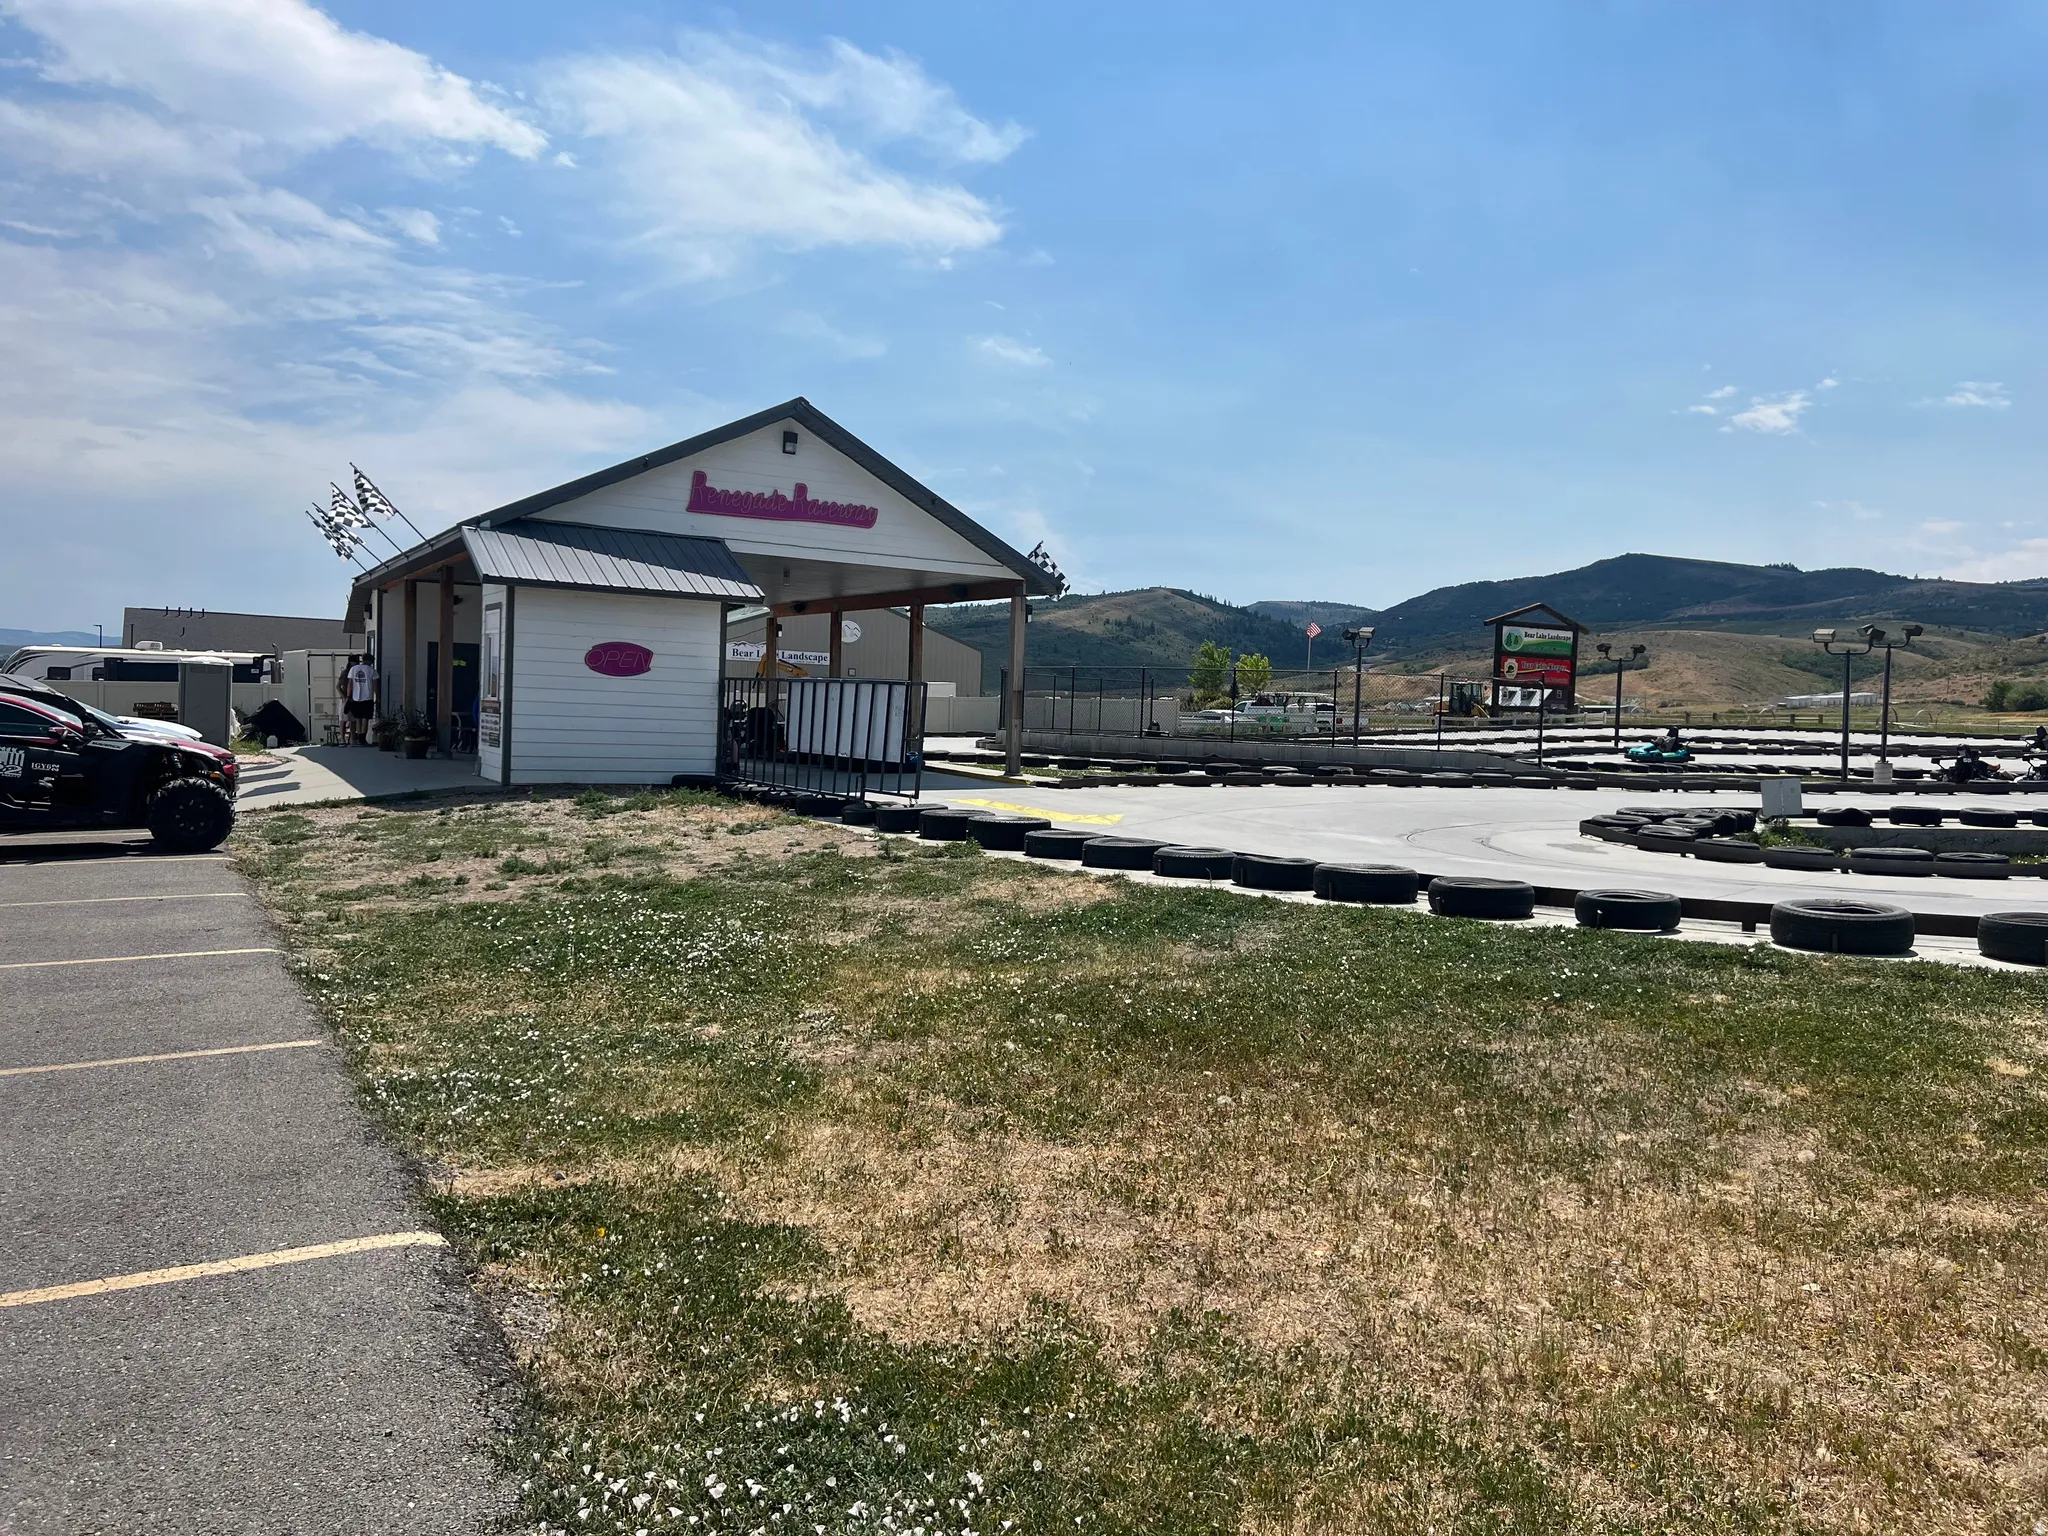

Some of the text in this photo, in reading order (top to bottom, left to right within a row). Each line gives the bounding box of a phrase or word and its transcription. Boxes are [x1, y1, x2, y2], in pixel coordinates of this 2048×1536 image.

[691, 471, 878, 520] Renegade Raceway
[1524, 631, 1571, 642] Bear Lake Landscape
[586, 649, 652, 670] OPEN
[732, 648, 754, 658] Bear
[781, 651, 828, 663] Landscape
